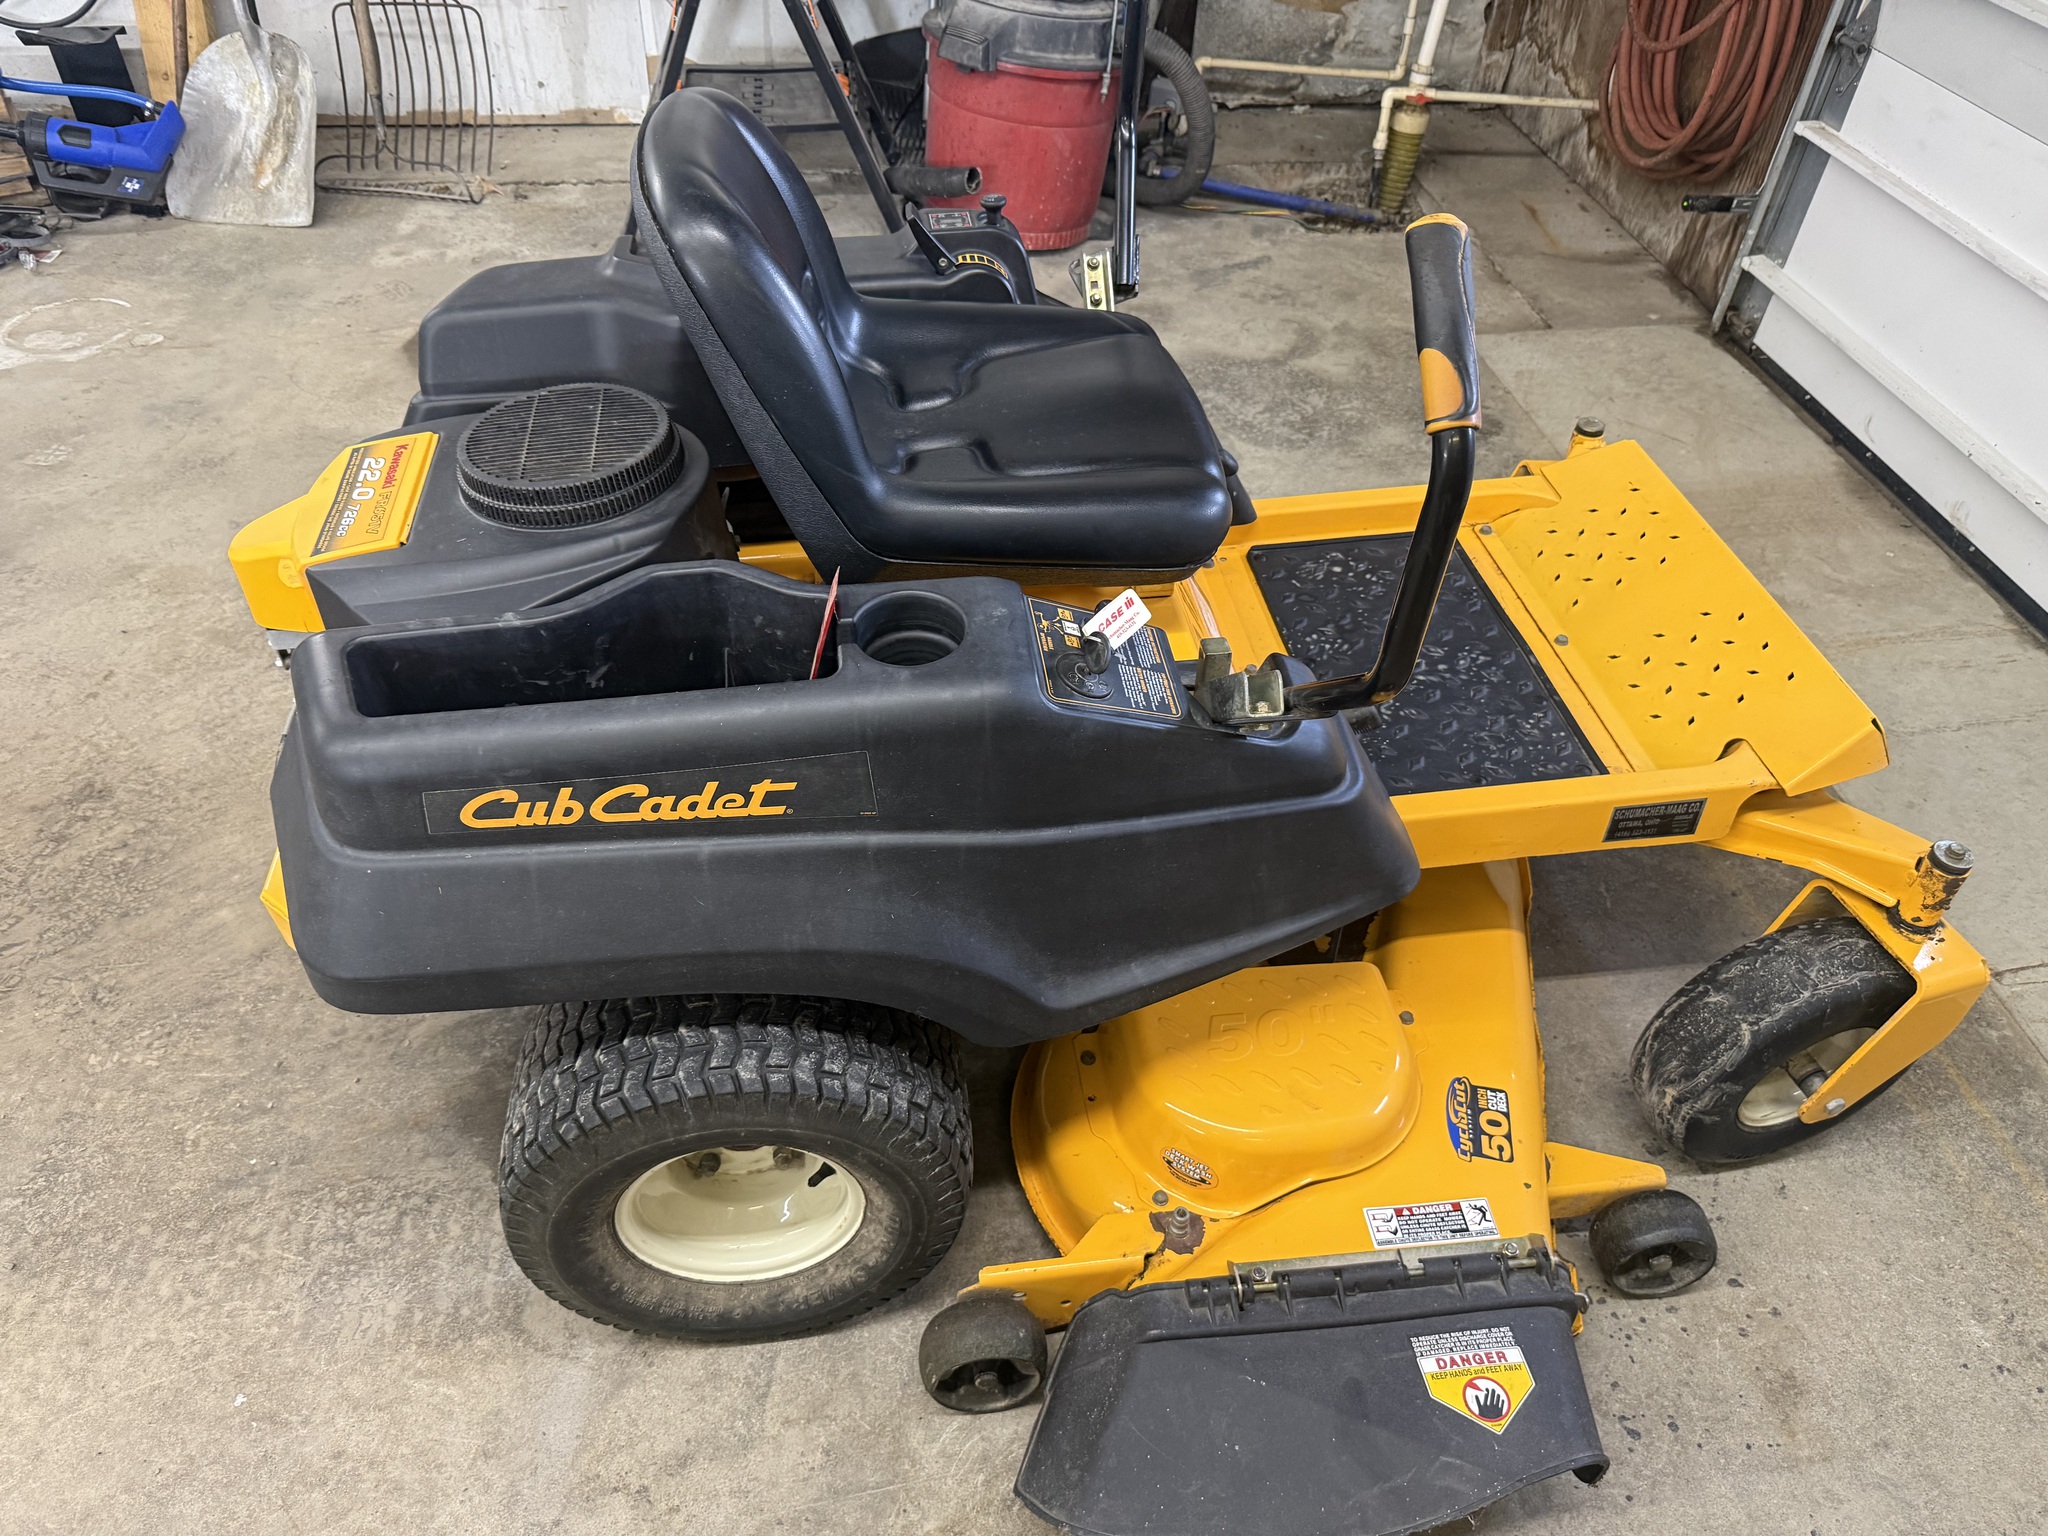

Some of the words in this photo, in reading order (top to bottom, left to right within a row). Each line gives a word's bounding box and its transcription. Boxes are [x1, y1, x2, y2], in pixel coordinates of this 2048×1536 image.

[382, 443, 409, 489] Kawasaki
[351, 457, 386, 500] 22.0
[336, 503, 362, 537] 726cc
[366, 490, 393, 534] FR651N
[1098, 606, 1124, 633] CASE
[459, 787, 584, 829] Cub
[589, 779, 797, 822] Cadet
[1614, 803, 1688, 820] SCHUMACHER-MAAG
[1688, 802, 1700, 812] CO.
[1477, 1088, 1487, 1108] INCH
[1487, 1090, 1497, 1110] CUT
[1496, 1091, 1508, 1112] DECK
[1479, 1110, 1511, 1161] 50
[1165, 1149, 1185, 1165] DECK
[1187, 1163, 1212, 1179] WASH
[1171, 1148, 1195, 1163] SMART
[1195, 1162, 1209, 1171] JET
[1171, 1161, 1201, 1180] SYSTEM
[1412, 1203, 1453, 1215] DANGER
[1430, 1371, 1448, 1380] KEEP
[1449, 1369, 1472, 1378] HANDS
[1472, 1367, 1485, 1375] and
[1486, 1365, 1502, 1374] FEET
[1504, 1363, 1523, 1372] AWAY
[1435, 1351, 1508, 1370] DANGER
